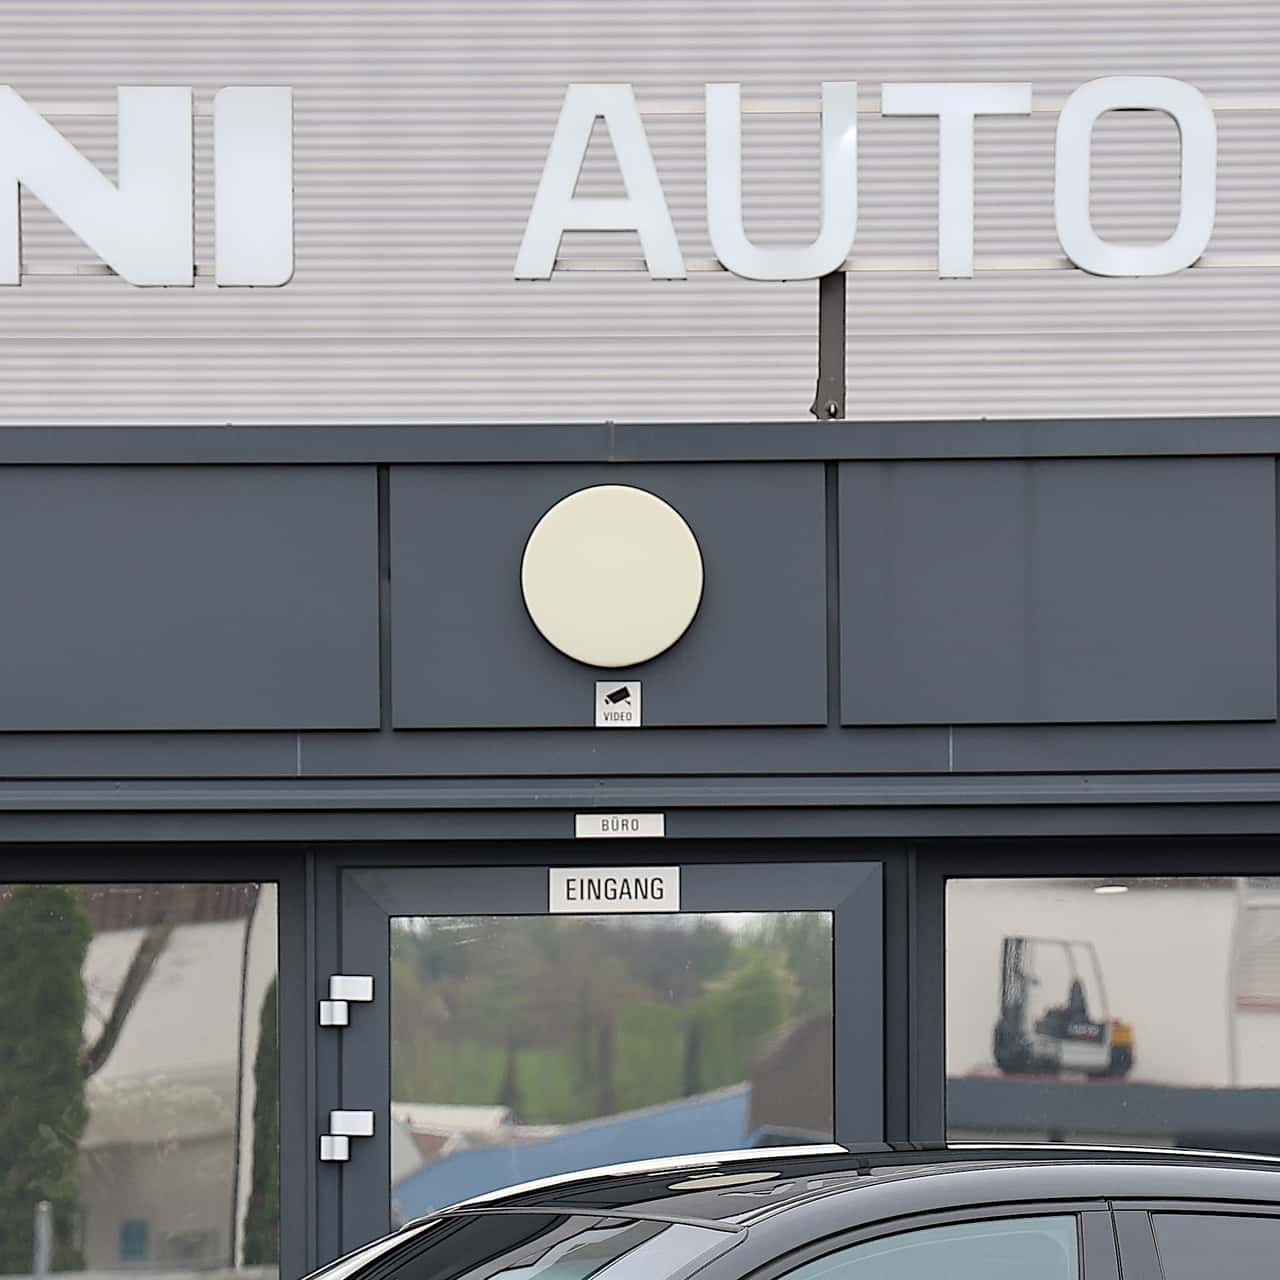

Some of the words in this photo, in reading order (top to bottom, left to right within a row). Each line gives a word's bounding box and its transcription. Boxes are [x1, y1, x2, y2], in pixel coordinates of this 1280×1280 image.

[514, 75, 1218, 281] AUTO
[603, 711, 633, 722] VIDEO
[601, 815, 640, 832] BÜRO
[565, 876, 665, 902] EINGANG
